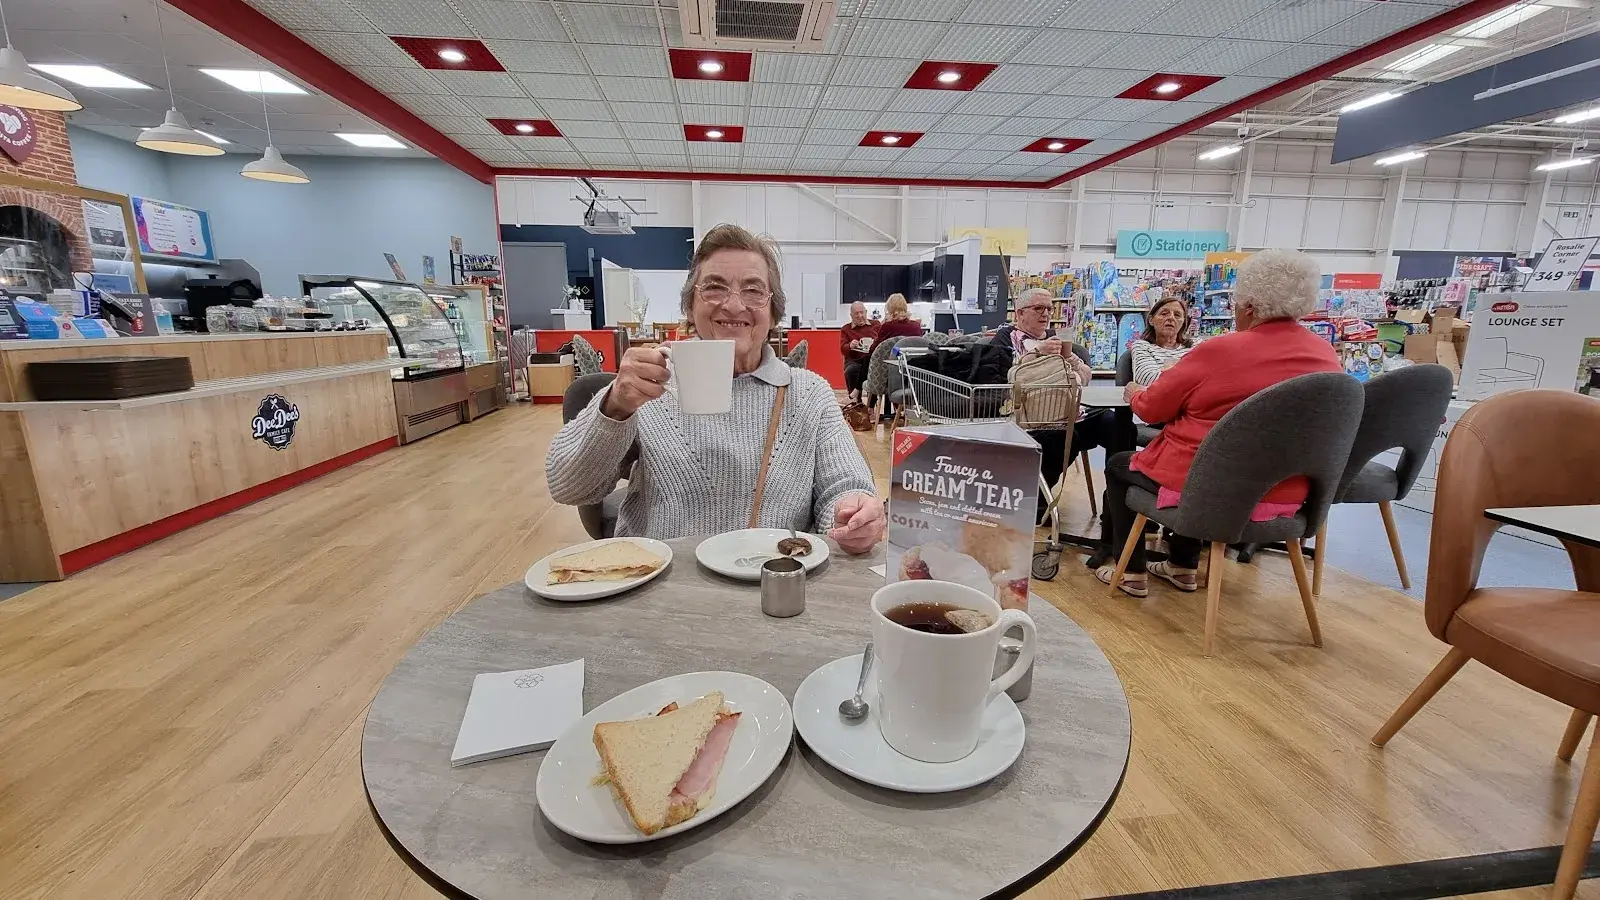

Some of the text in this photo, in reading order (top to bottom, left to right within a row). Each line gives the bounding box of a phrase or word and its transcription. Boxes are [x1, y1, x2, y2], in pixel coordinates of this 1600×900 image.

[1155, 239, 1220, 252] Stationery
[1488, 317, 1565, 327] LOUNGE SET
[932, 455, 993, 485] Fancy a
[902, 469, 1024, 511] CREAM TEA?
[920, 506, 933, 515] with
[952, 514, 968, 522] small
[961, 505, 983, 516] clotted
[891, 514, 929, 530] COSTA
